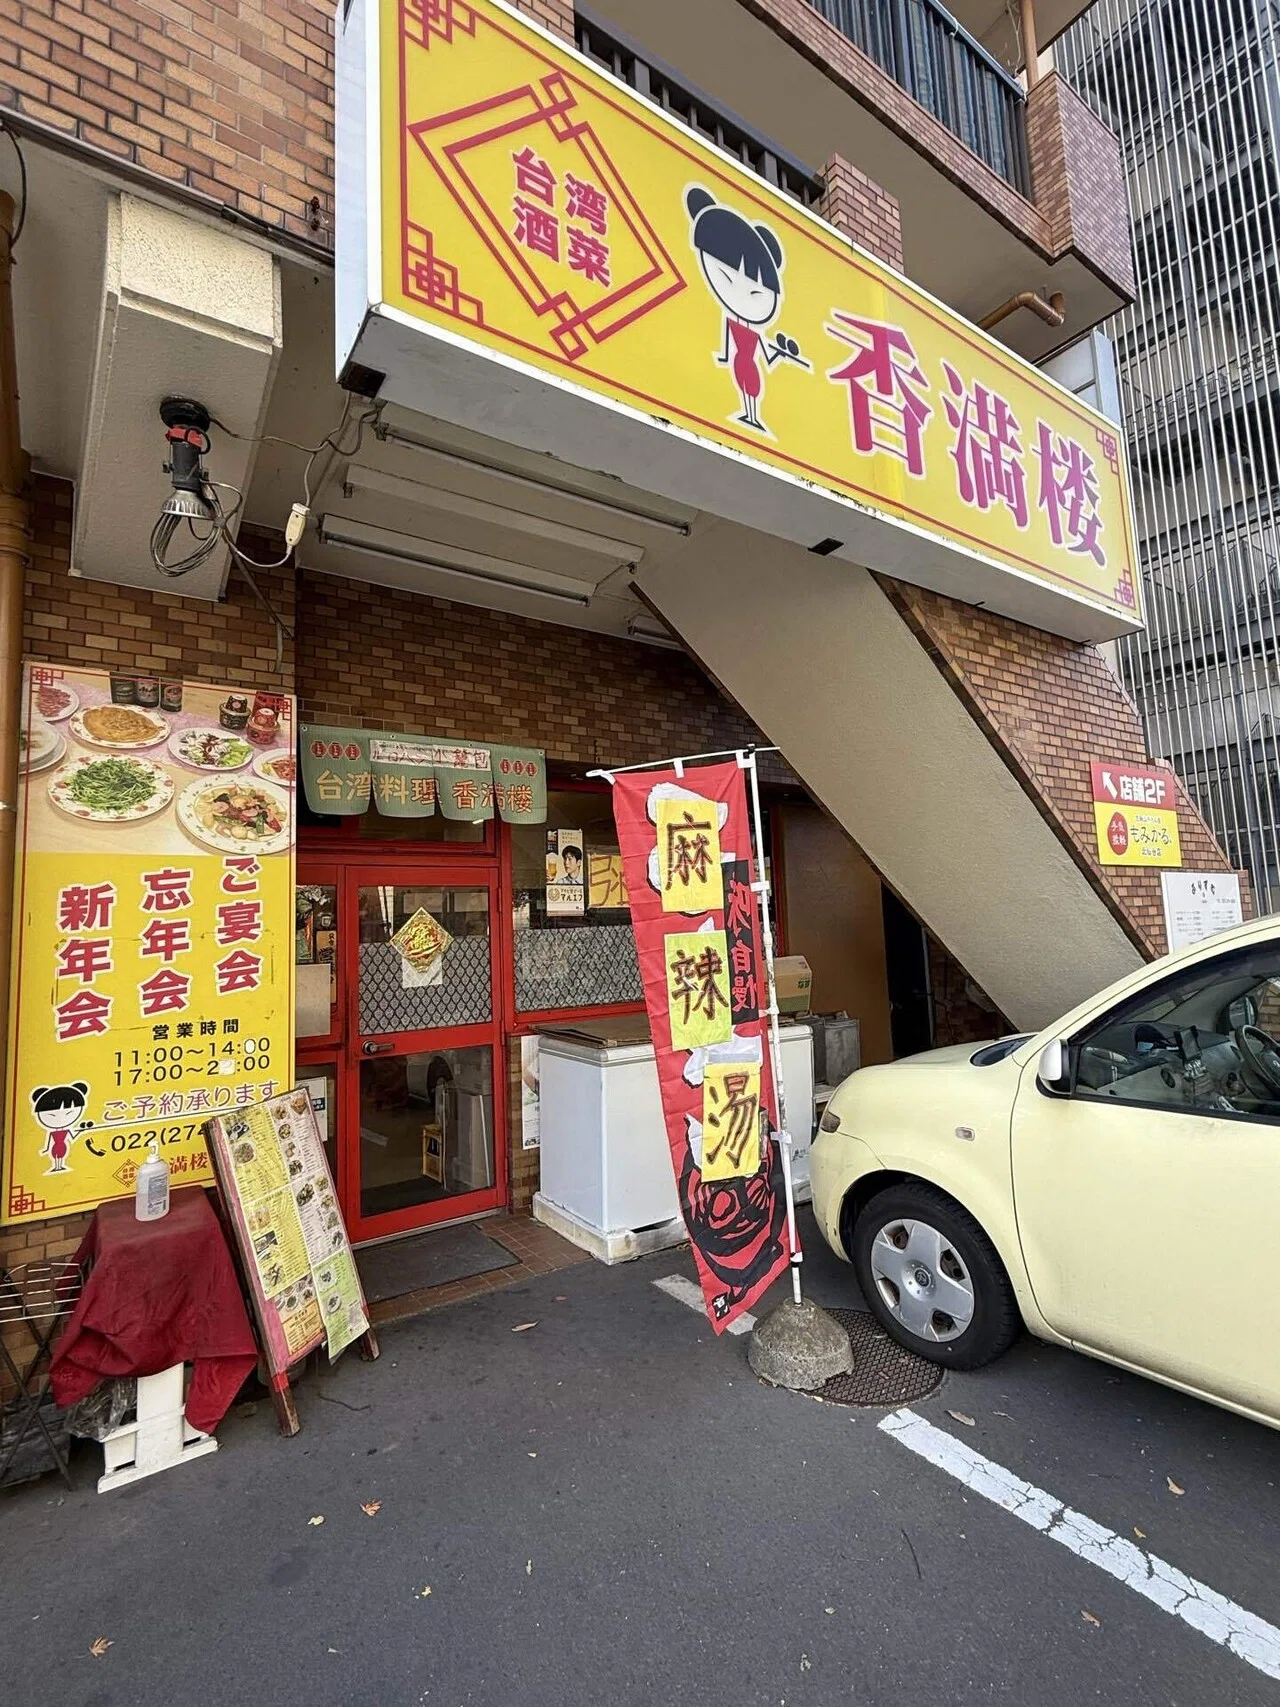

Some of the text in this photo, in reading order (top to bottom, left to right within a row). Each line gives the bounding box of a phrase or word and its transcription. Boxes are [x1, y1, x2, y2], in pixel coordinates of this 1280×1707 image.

[512, 147, 608, 236] 台湾
[513, 194, 612, 289] 酒菜
[827, 309, 1106, 569] 香満楼
[316, 770, 533, 813] 台湾料理 香満楼
[58, 884, 115, 1039] 新年会
[143, 869, 192, 1015] 忘年会
[217, 856, 262, 993] ご宴会
[115, 1054, 270, 1087] 17:00～2:00
[152, 1018, 240, 1041] 営業時間
[104, 1081, 280, 1122] ご予約承ります
[169, 1152, 208, 1175] 満楼
